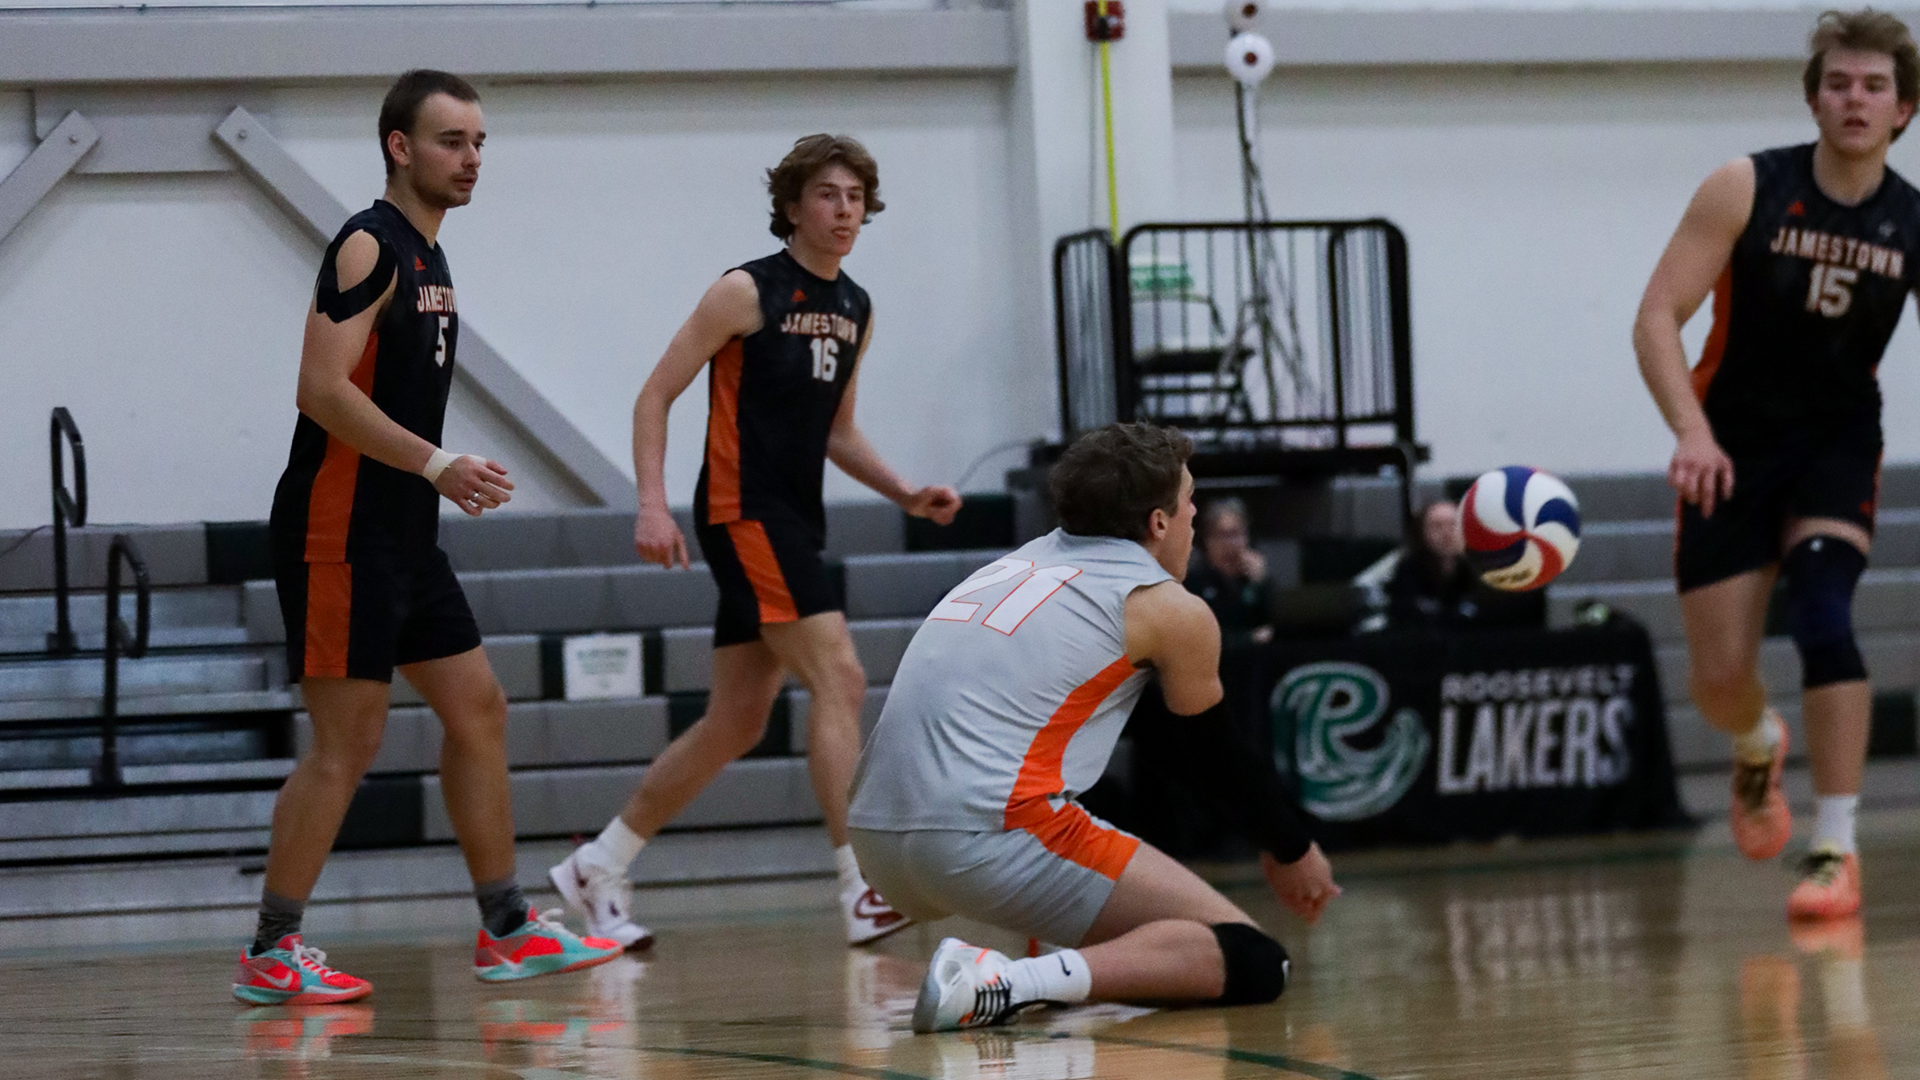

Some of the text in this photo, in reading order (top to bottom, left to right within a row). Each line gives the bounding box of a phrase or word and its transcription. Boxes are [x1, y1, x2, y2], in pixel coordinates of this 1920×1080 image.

[1770, 227, 1904, 279] JAMESTOWN
[1806, 263, 1858, 318] 15
[435, 316, 449, 367] 5
[810, 338, 839, 382] 16
[925, 558, 1082, 636] 21
[1440, 664, 1634, 701] ROOSEVELT
[1437, 698, 1633, 794] LAKERS
